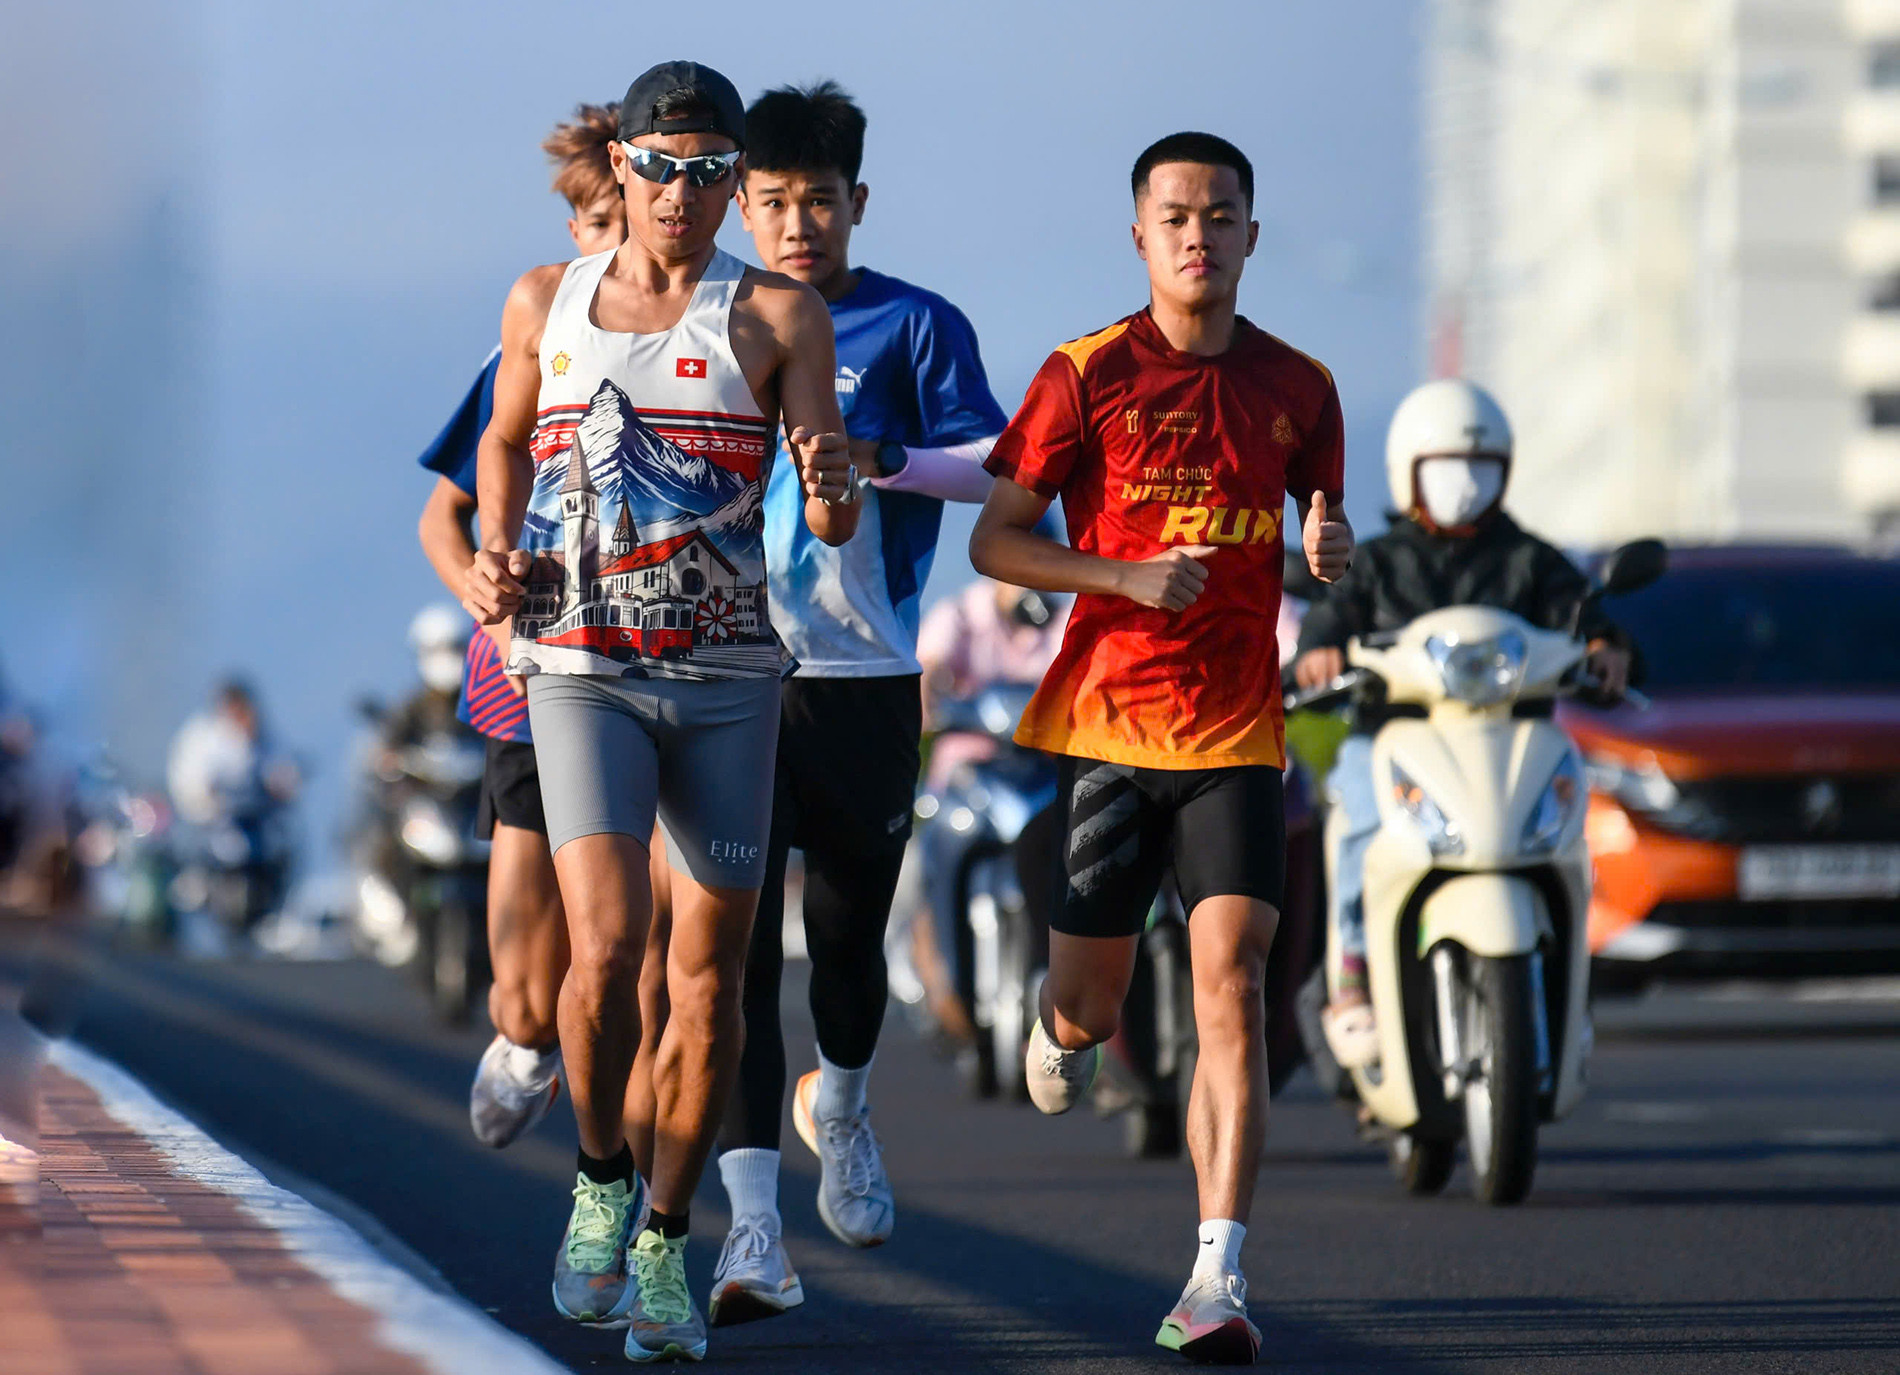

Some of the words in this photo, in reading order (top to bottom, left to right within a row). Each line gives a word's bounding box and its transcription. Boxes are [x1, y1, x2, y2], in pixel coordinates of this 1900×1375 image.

[1143, 467, 1172, 481] TAM
[1176, 465, 1213, 481] CHÚC
[1120, 482, 1213, 503] NIGHT
[1158, 505, 1284, 545] RUN
[710, 840, 758, 858] Elite
